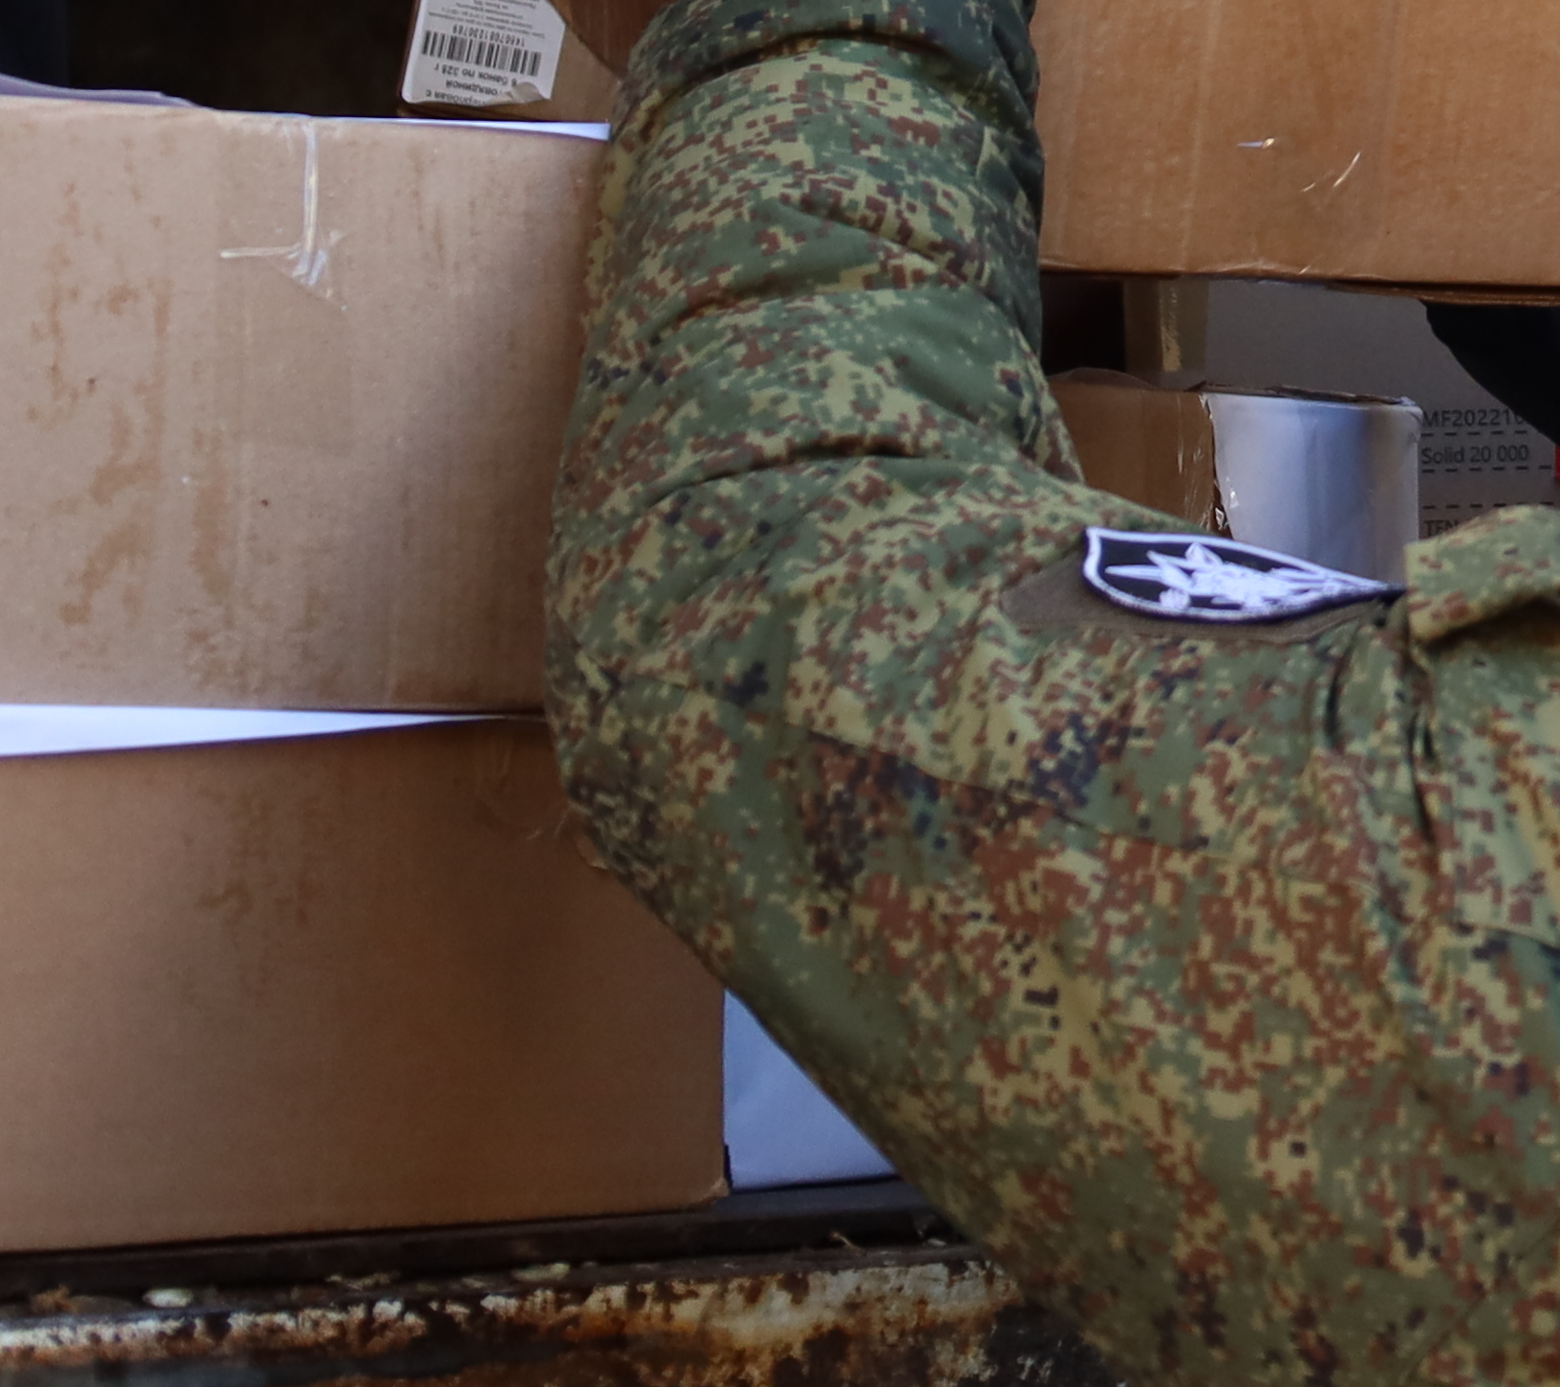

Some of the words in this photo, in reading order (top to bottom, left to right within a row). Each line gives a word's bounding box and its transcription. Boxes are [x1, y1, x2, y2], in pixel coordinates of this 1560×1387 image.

[461, 67, 475, 78] по
[477, 70, 509, 86] банок
[1422, 446, 1465, 464] Solid
[1470, 445, 1491, 463] 20
